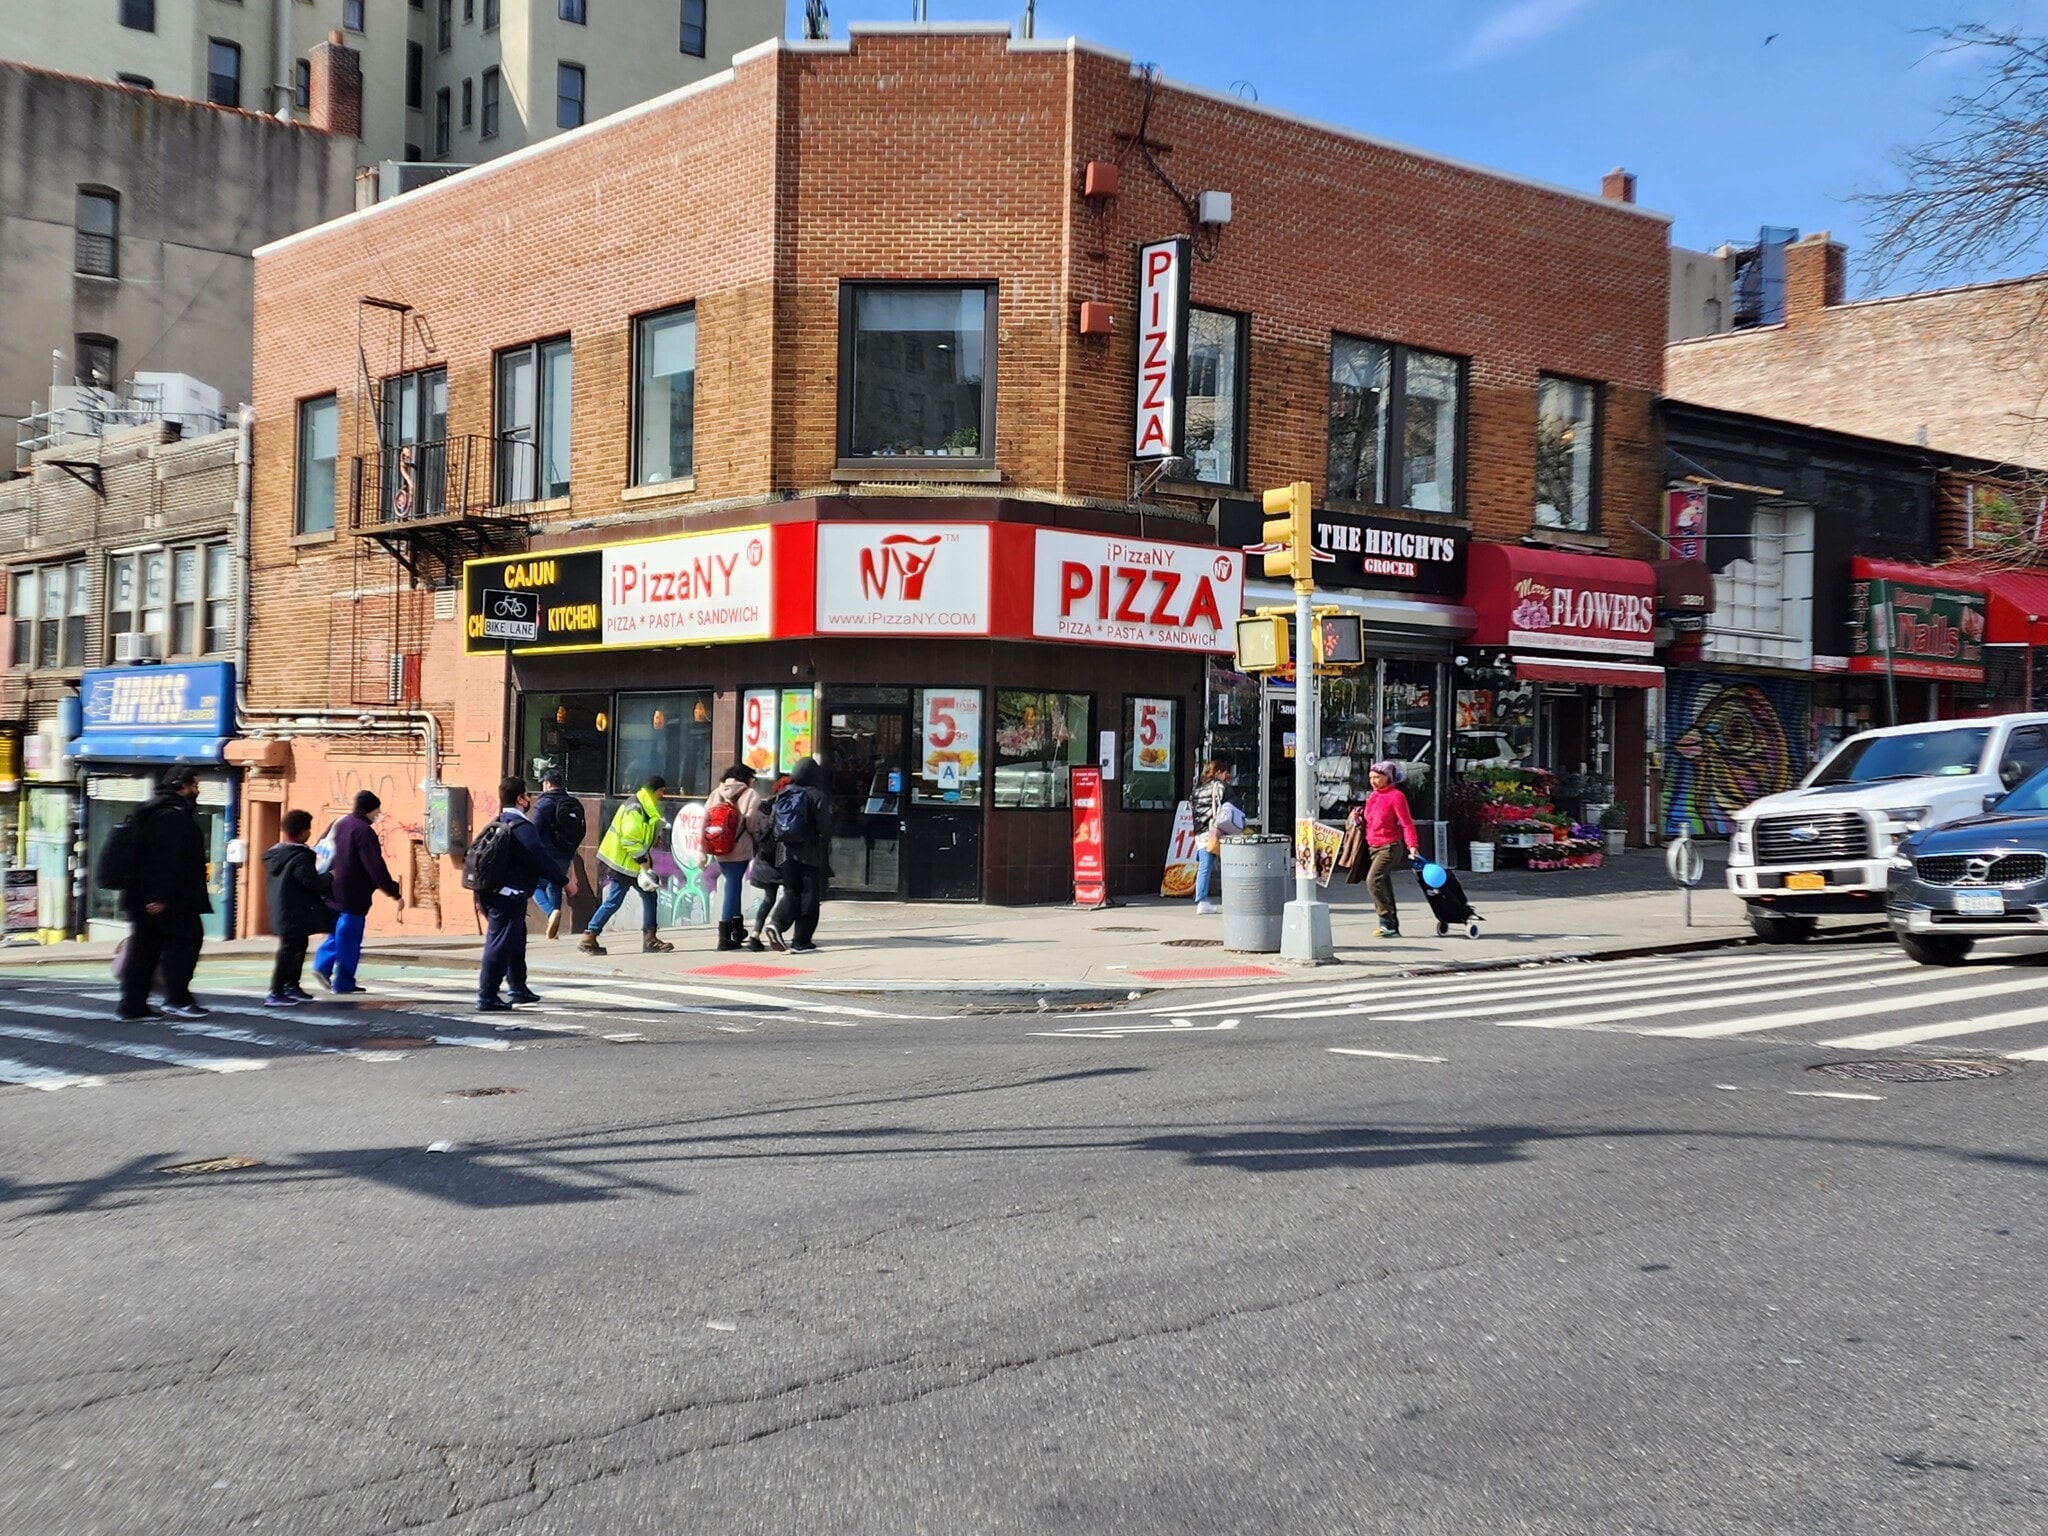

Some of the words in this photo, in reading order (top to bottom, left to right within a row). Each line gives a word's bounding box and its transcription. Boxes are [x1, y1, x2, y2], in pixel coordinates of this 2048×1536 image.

[1138, 251, 1171, 451] PIZZA
[1107, 543, 1175, 567] iPizzaNY
[1317, 523, 1361, 551] THE
[1365, 527, 1454, 561] HEIGHTS
[504, 560, 555, 589] CAJUN
[611, 552, 739, 606] iPizzaNY
[1364, 558, 1415, 576] GROCER
[1060, 561, 1222, 630] PIZZA
[1514, 578, 1551, 599] Merry
[548, 605, 596, 631] KITCHEN
[607, 616, 636, 632] PIZZA
[649, 612, 684, 629] PASTA
[697, 606, 758, 626] SANDWICH
[1552, 588, 1653, 633] FLOWERS
[485, 621, 505, 633] BIKE
[509, 624, 533, 635] LANE
[1059, 621, 1092, 636] PIZZA
[1107, 625, 1144, 641] PASTA
[1158, 630, 1216, 646] SANDWICH
[943, 766, 954, 779] A
